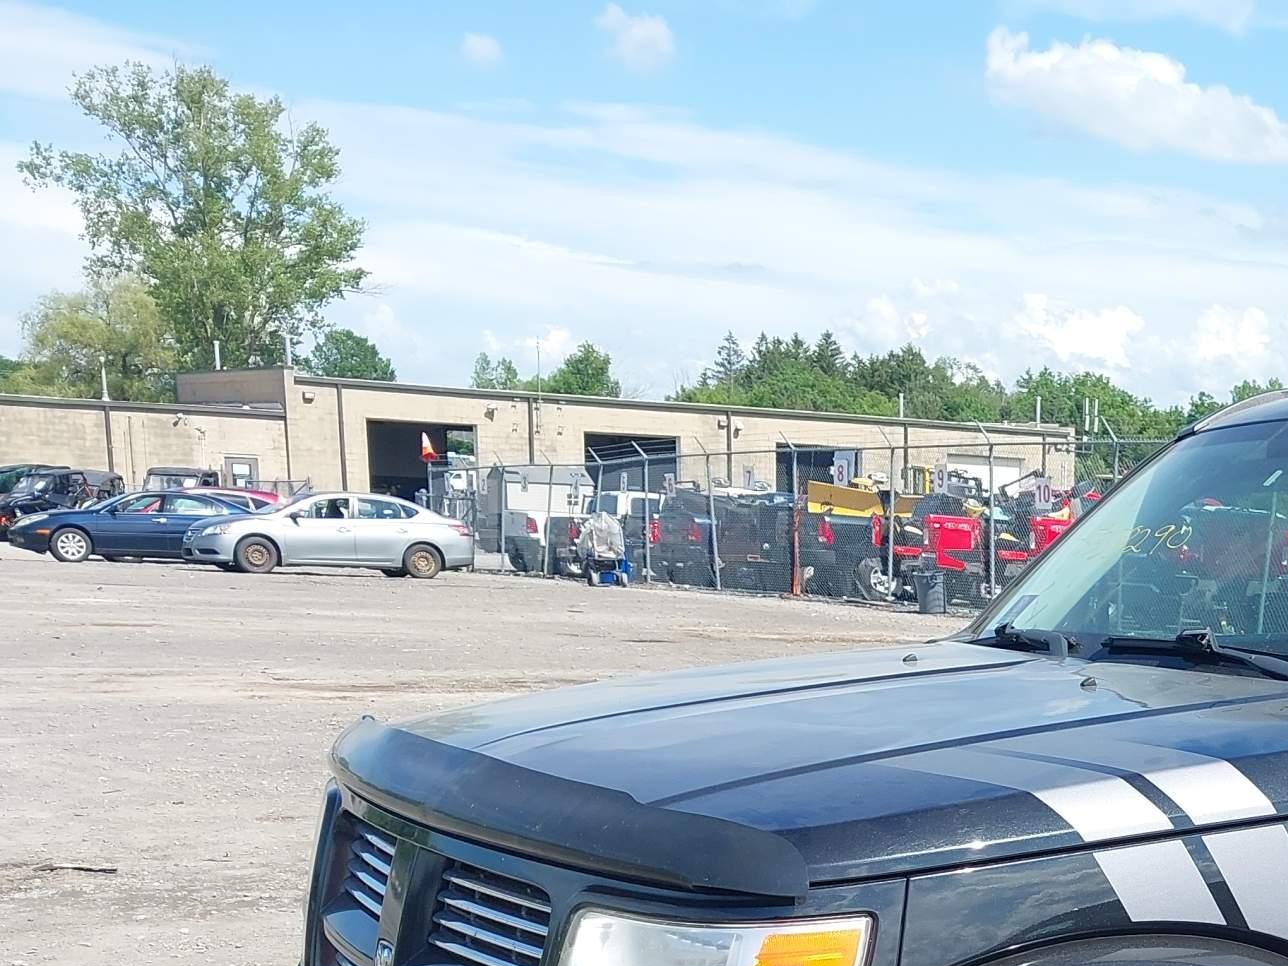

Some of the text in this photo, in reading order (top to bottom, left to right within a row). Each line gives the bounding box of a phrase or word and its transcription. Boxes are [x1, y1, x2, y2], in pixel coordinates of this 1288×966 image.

[837, 464, 844, 482] 8
[937, 469, 944, 488] 9
[1036, 483, 1050, 504] 10
